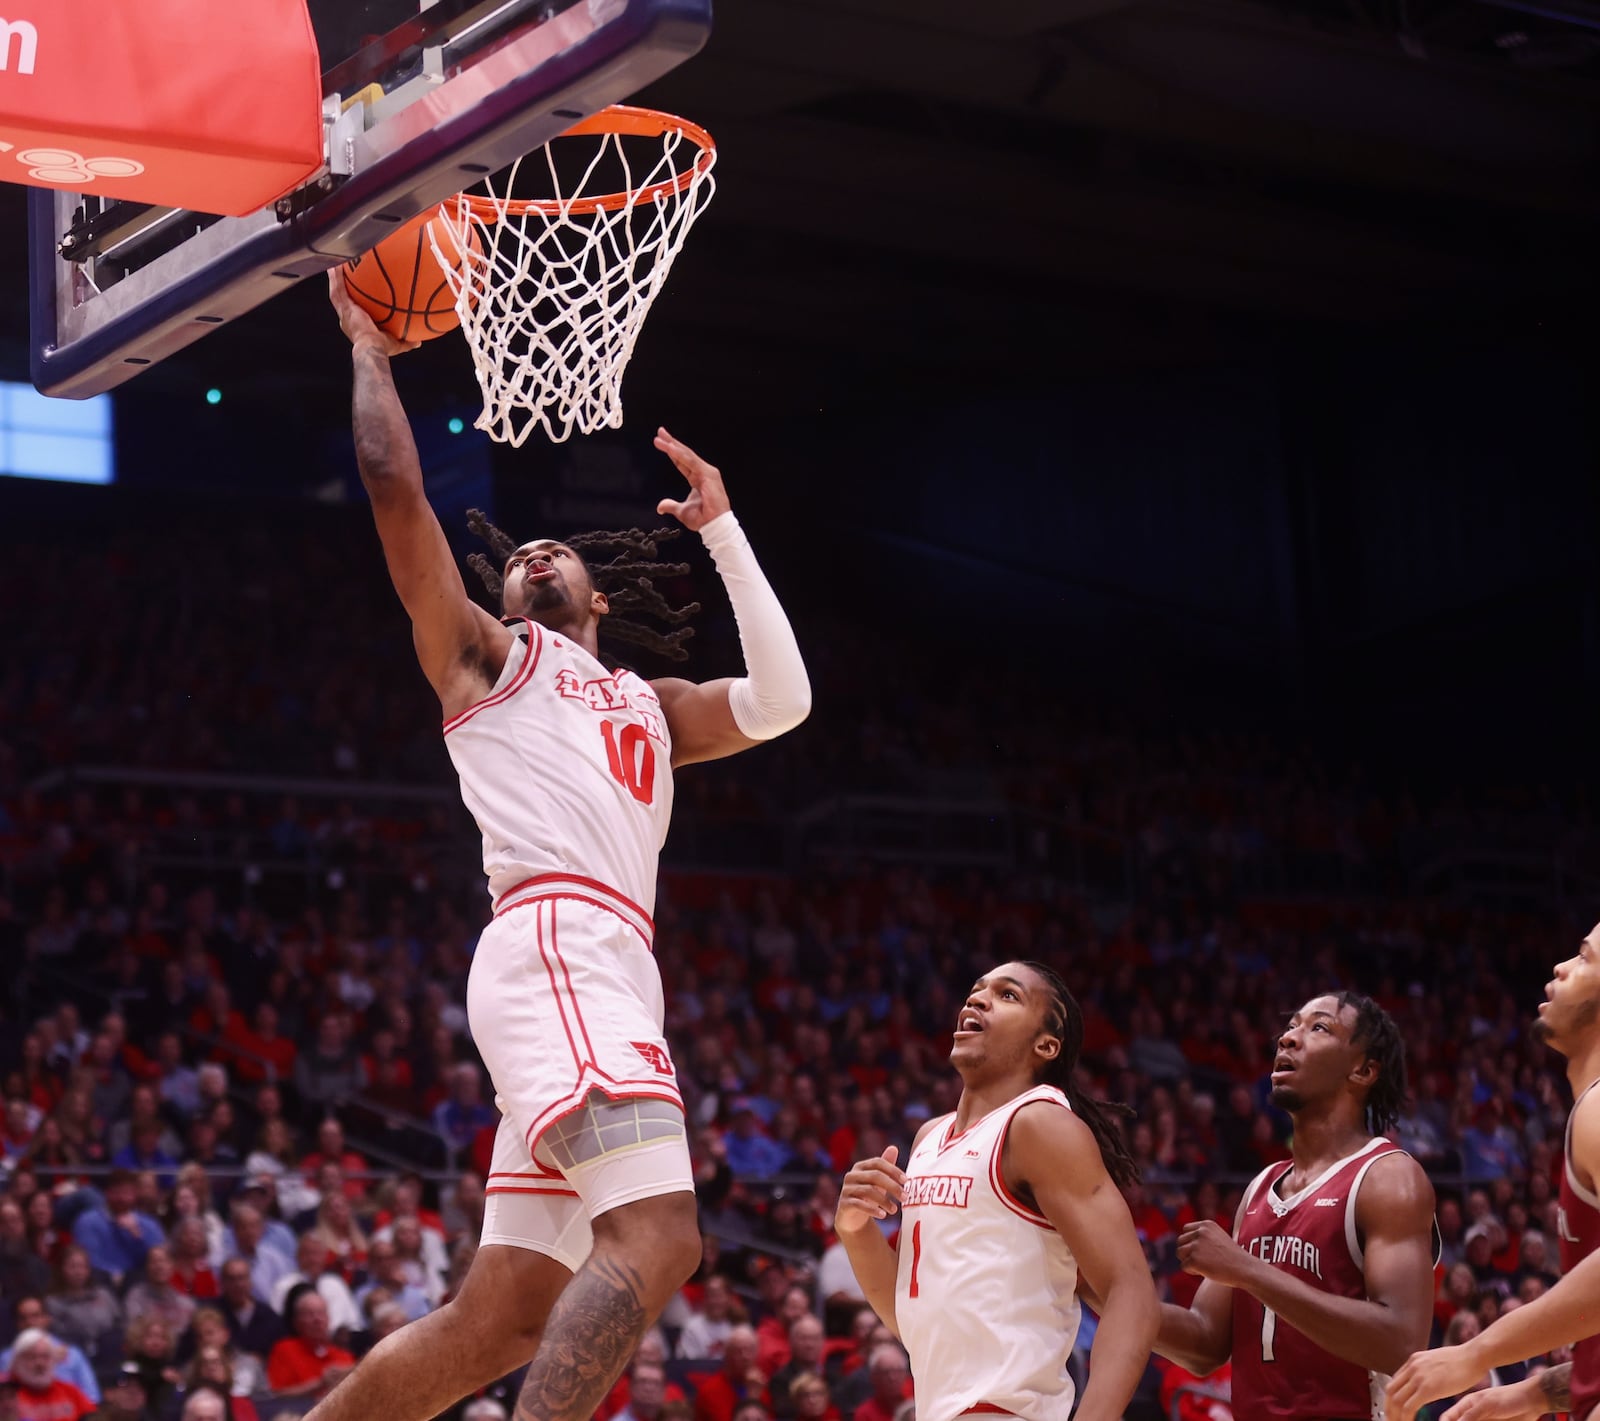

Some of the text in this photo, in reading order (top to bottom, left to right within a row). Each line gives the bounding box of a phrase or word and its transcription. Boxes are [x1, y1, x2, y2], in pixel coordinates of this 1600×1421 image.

[601, 720, 654, 805] 10
[909, 1220, 921, 1298] 1
[1249, 1235, 1323, 1280] CENTRAL
[1262, 1304, 1275, 1361] 1
